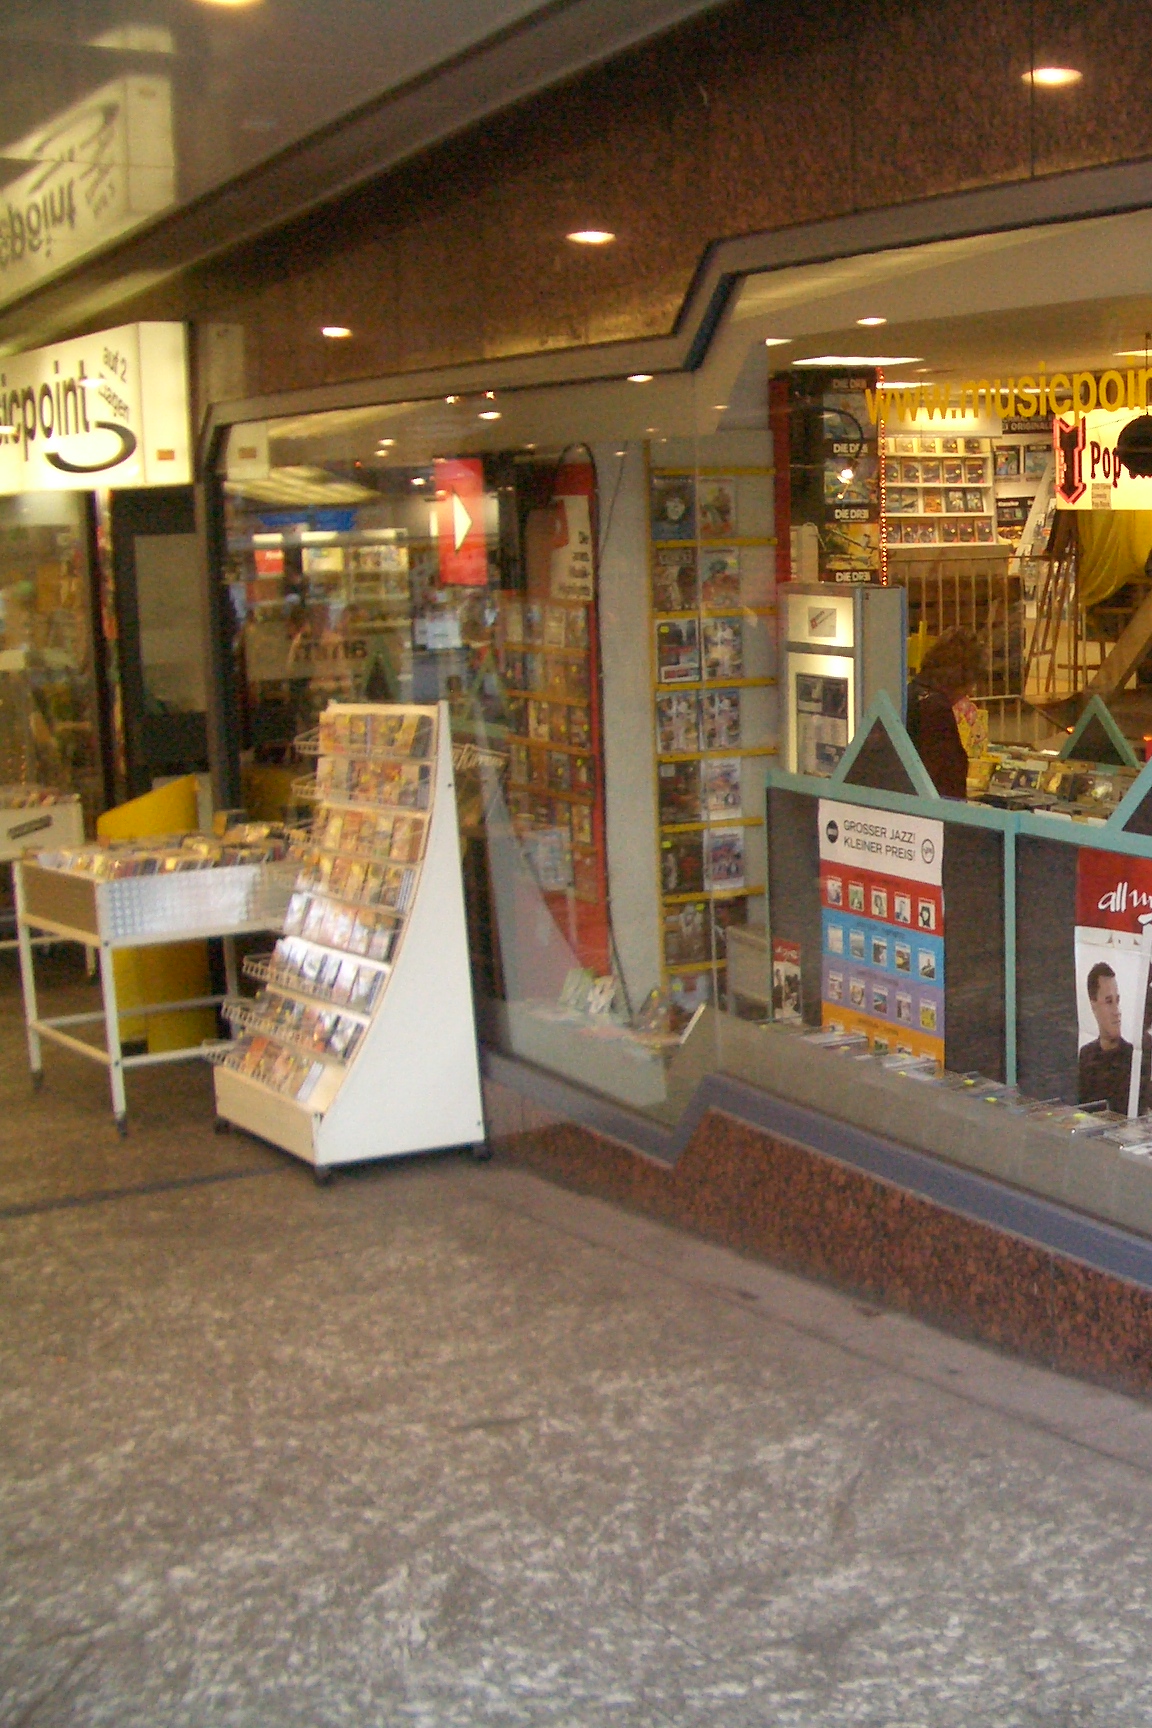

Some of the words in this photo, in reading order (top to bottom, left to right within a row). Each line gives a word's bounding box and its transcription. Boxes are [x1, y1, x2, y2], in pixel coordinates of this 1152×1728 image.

[0, 360, 90, 462] icpoint
[843, 820, 887, 838] GROSSER
[889, 829, 916, 845] JAZZ!
[843, 836, 882, 854] KLEINER
[885, 845, 916, 861] PREIS!
[1098, 881, 1128, 913] all
